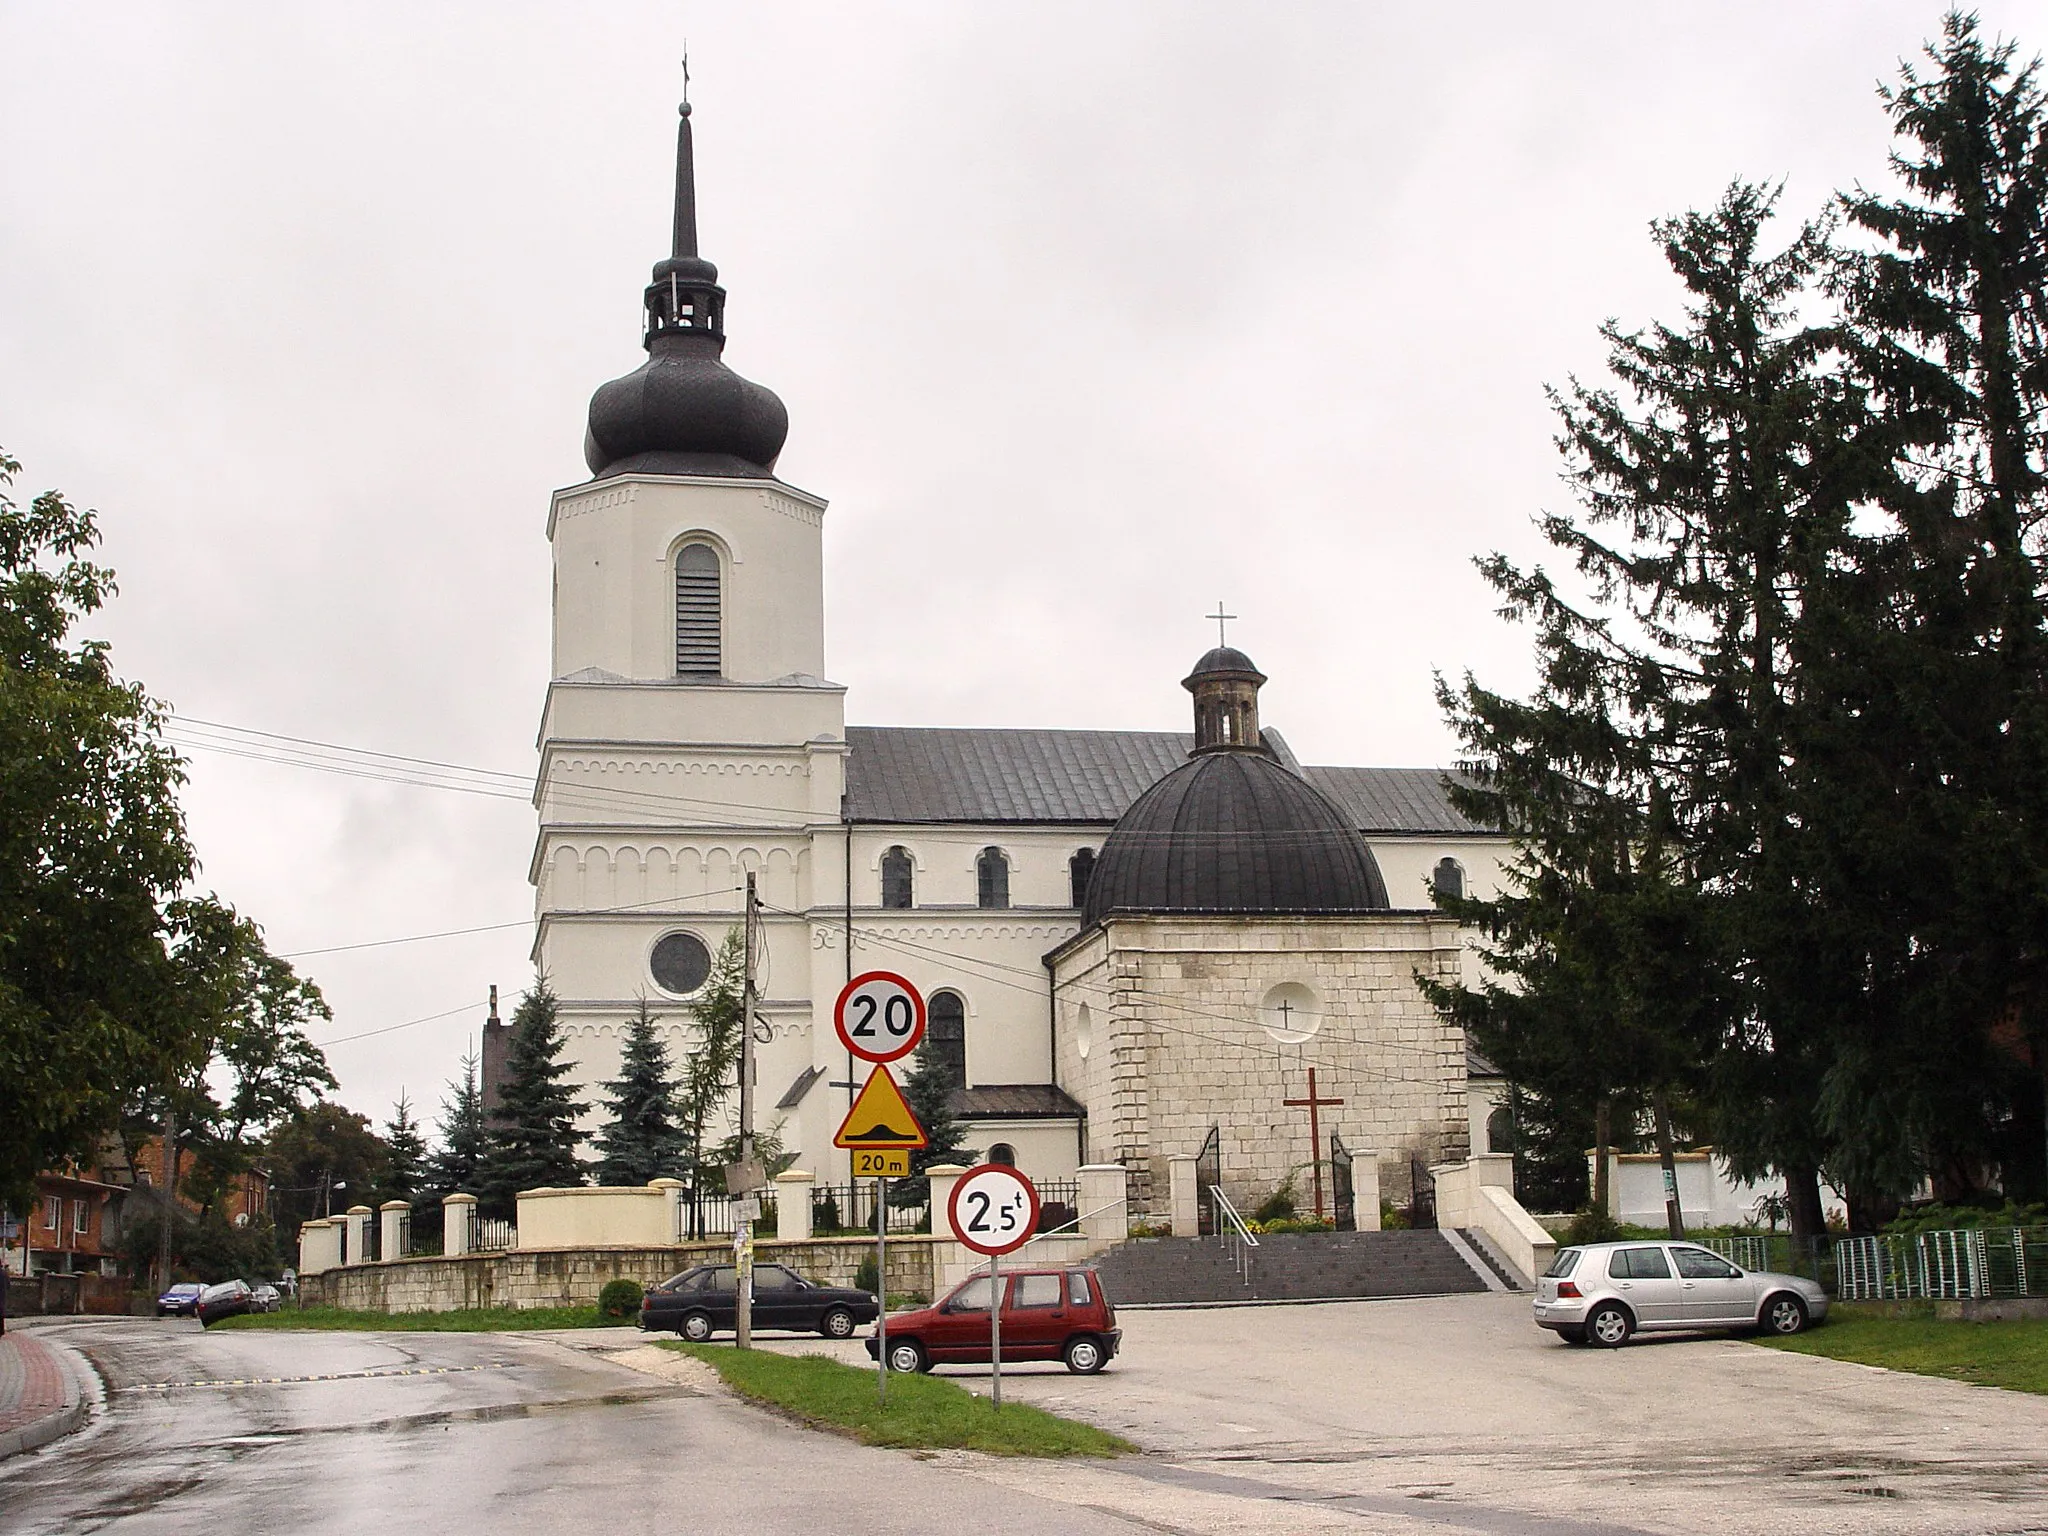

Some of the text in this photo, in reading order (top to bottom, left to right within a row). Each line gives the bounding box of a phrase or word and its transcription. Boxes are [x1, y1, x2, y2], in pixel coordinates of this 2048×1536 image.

[851, 994, 913, 1037] 20
[861, 1154, 902, 1172] 20 m
